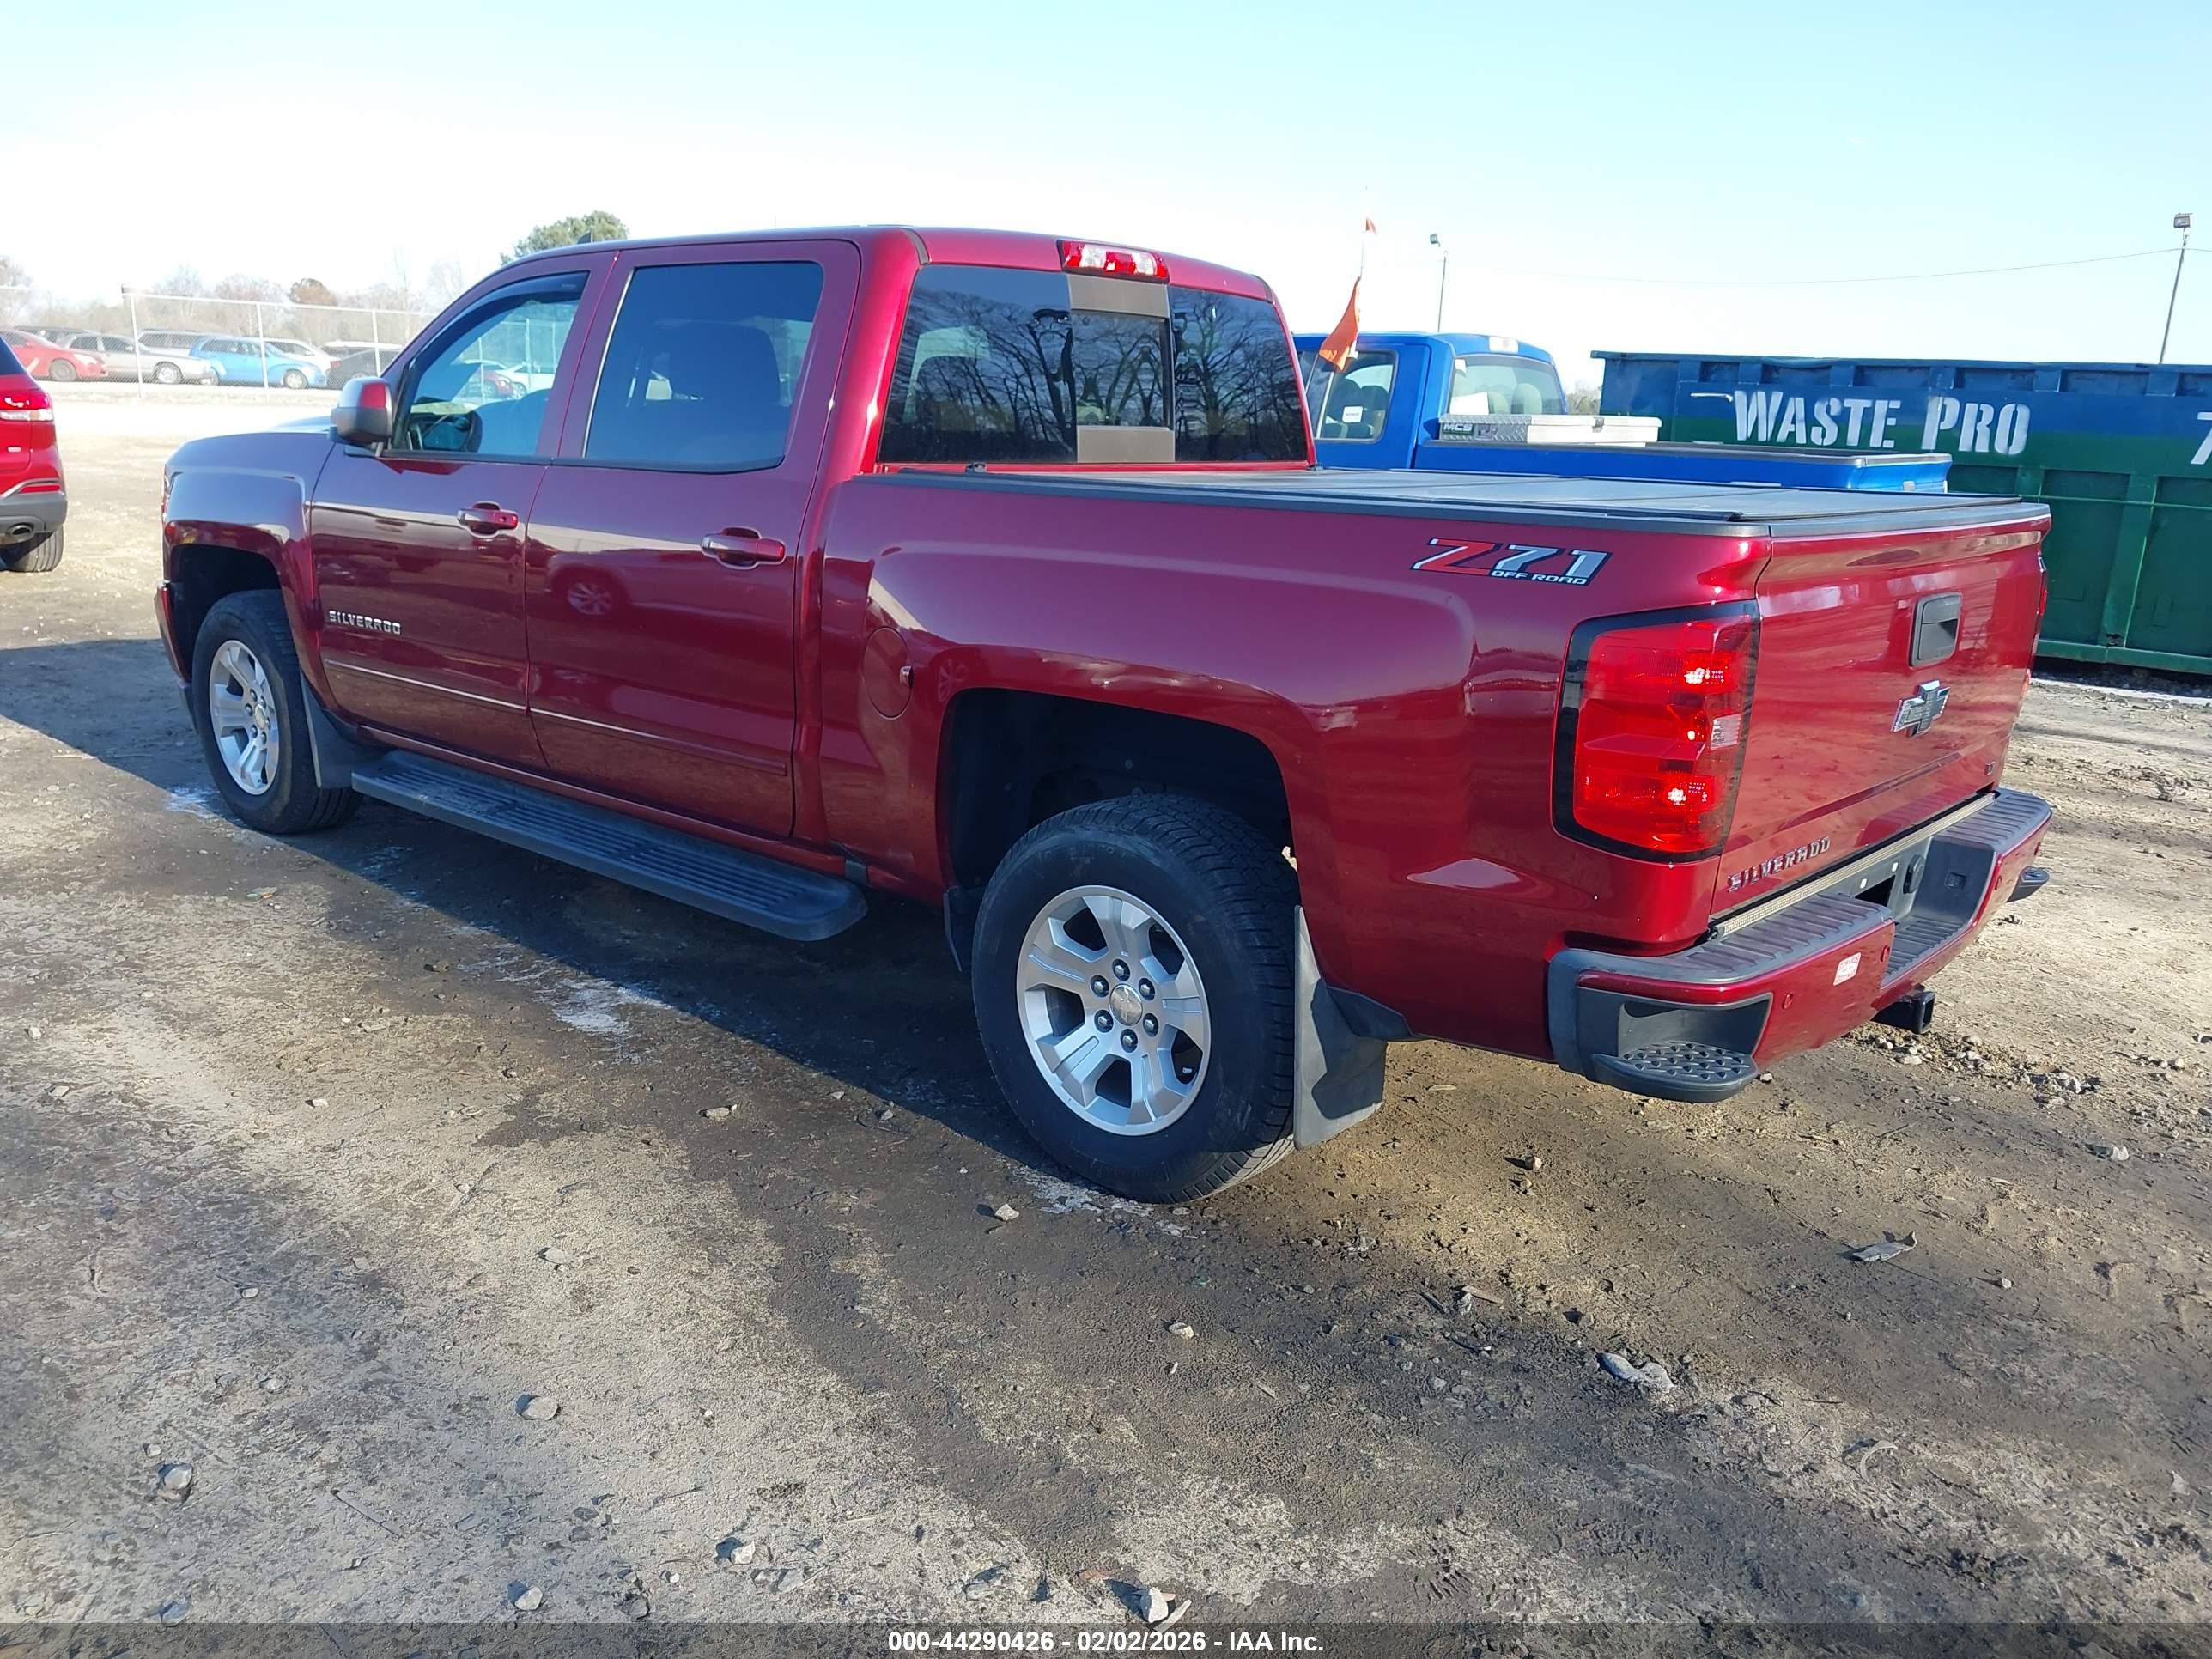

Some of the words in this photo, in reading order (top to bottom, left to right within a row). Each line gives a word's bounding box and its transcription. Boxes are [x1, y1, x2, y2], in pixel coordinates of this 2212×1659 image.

[1735, 391, 1901, 447] WASTE
[1921, 395, 2030, 454] PRO
[1411, 538, 1610, 579] Z71
[1491, 570, 1528, 579] OFF
[1531, 574, 1588, 585] ROAD
[329, 610, 401, 635] SILVERADO
[1727, 836, 1831, 893] SILVERADO
